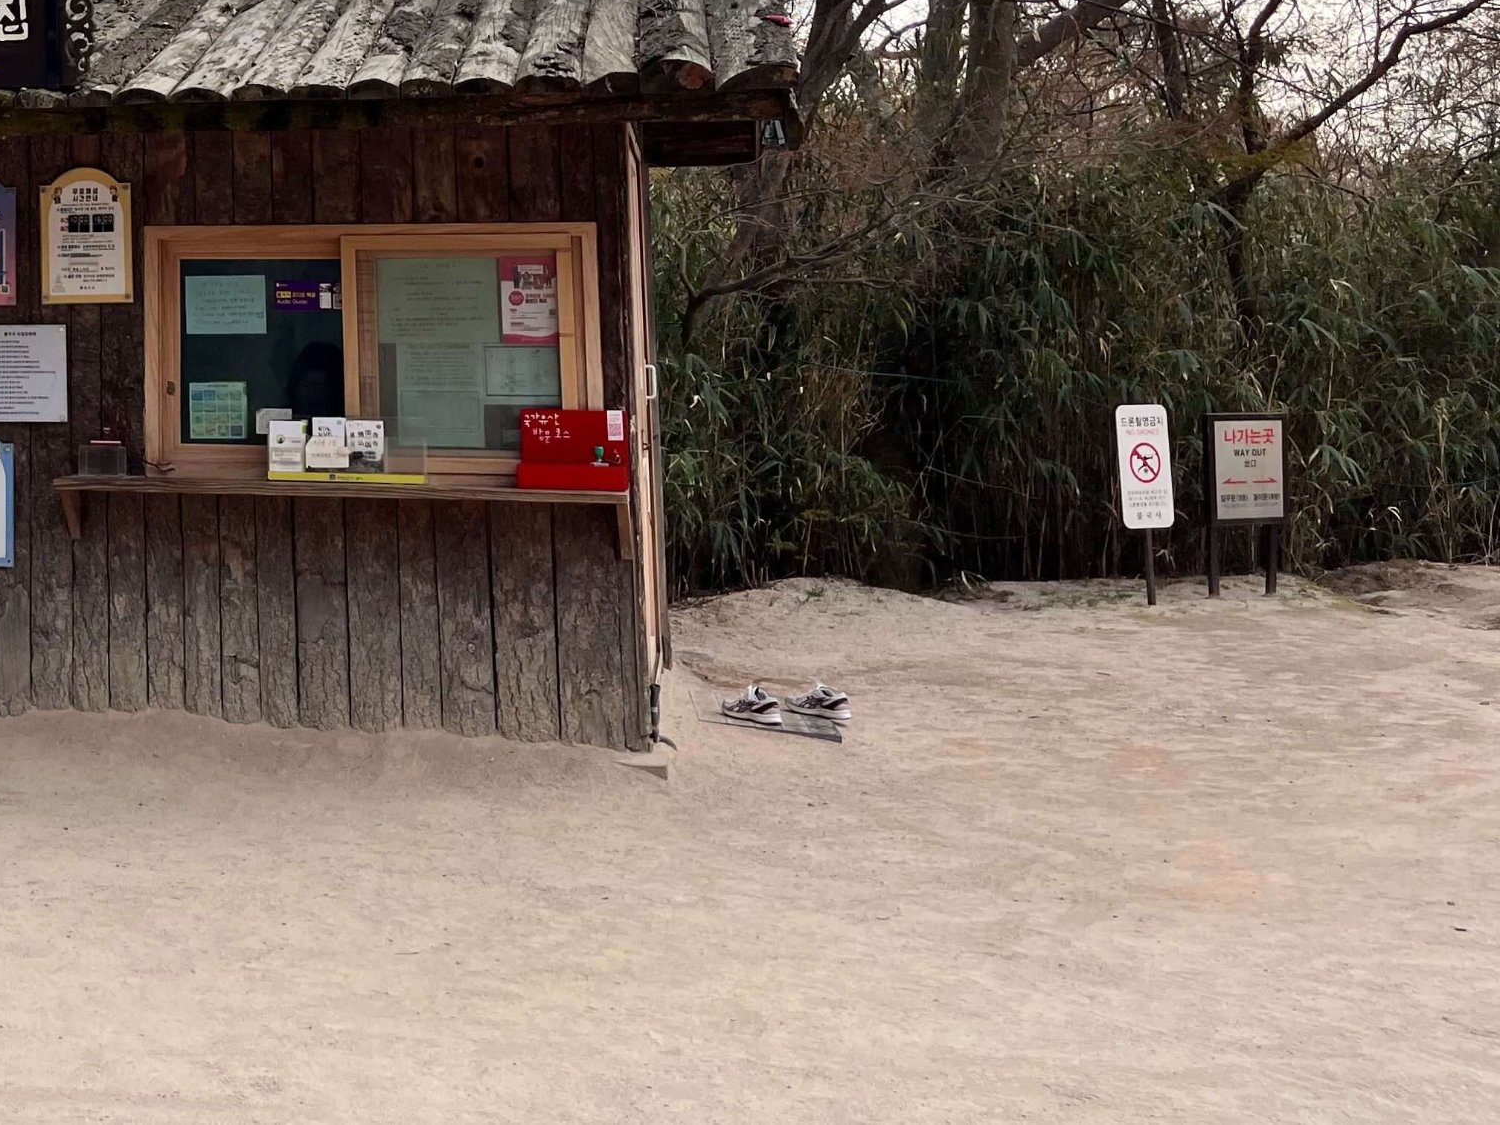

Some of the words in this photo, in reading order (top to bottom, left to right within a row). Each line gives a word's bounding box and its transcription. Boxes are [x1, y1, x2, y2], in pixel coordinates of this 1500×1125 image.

[523, 412, 560, 428] 국가유산
[532, 427, 551, 444] 방문
[554, 427, 571, 439] 코스
[1224, 428, 1275, 445] 나가는곳
[1233, 448, 1250, 457] WAY
[1251, 448, 1267, 457] OUT
